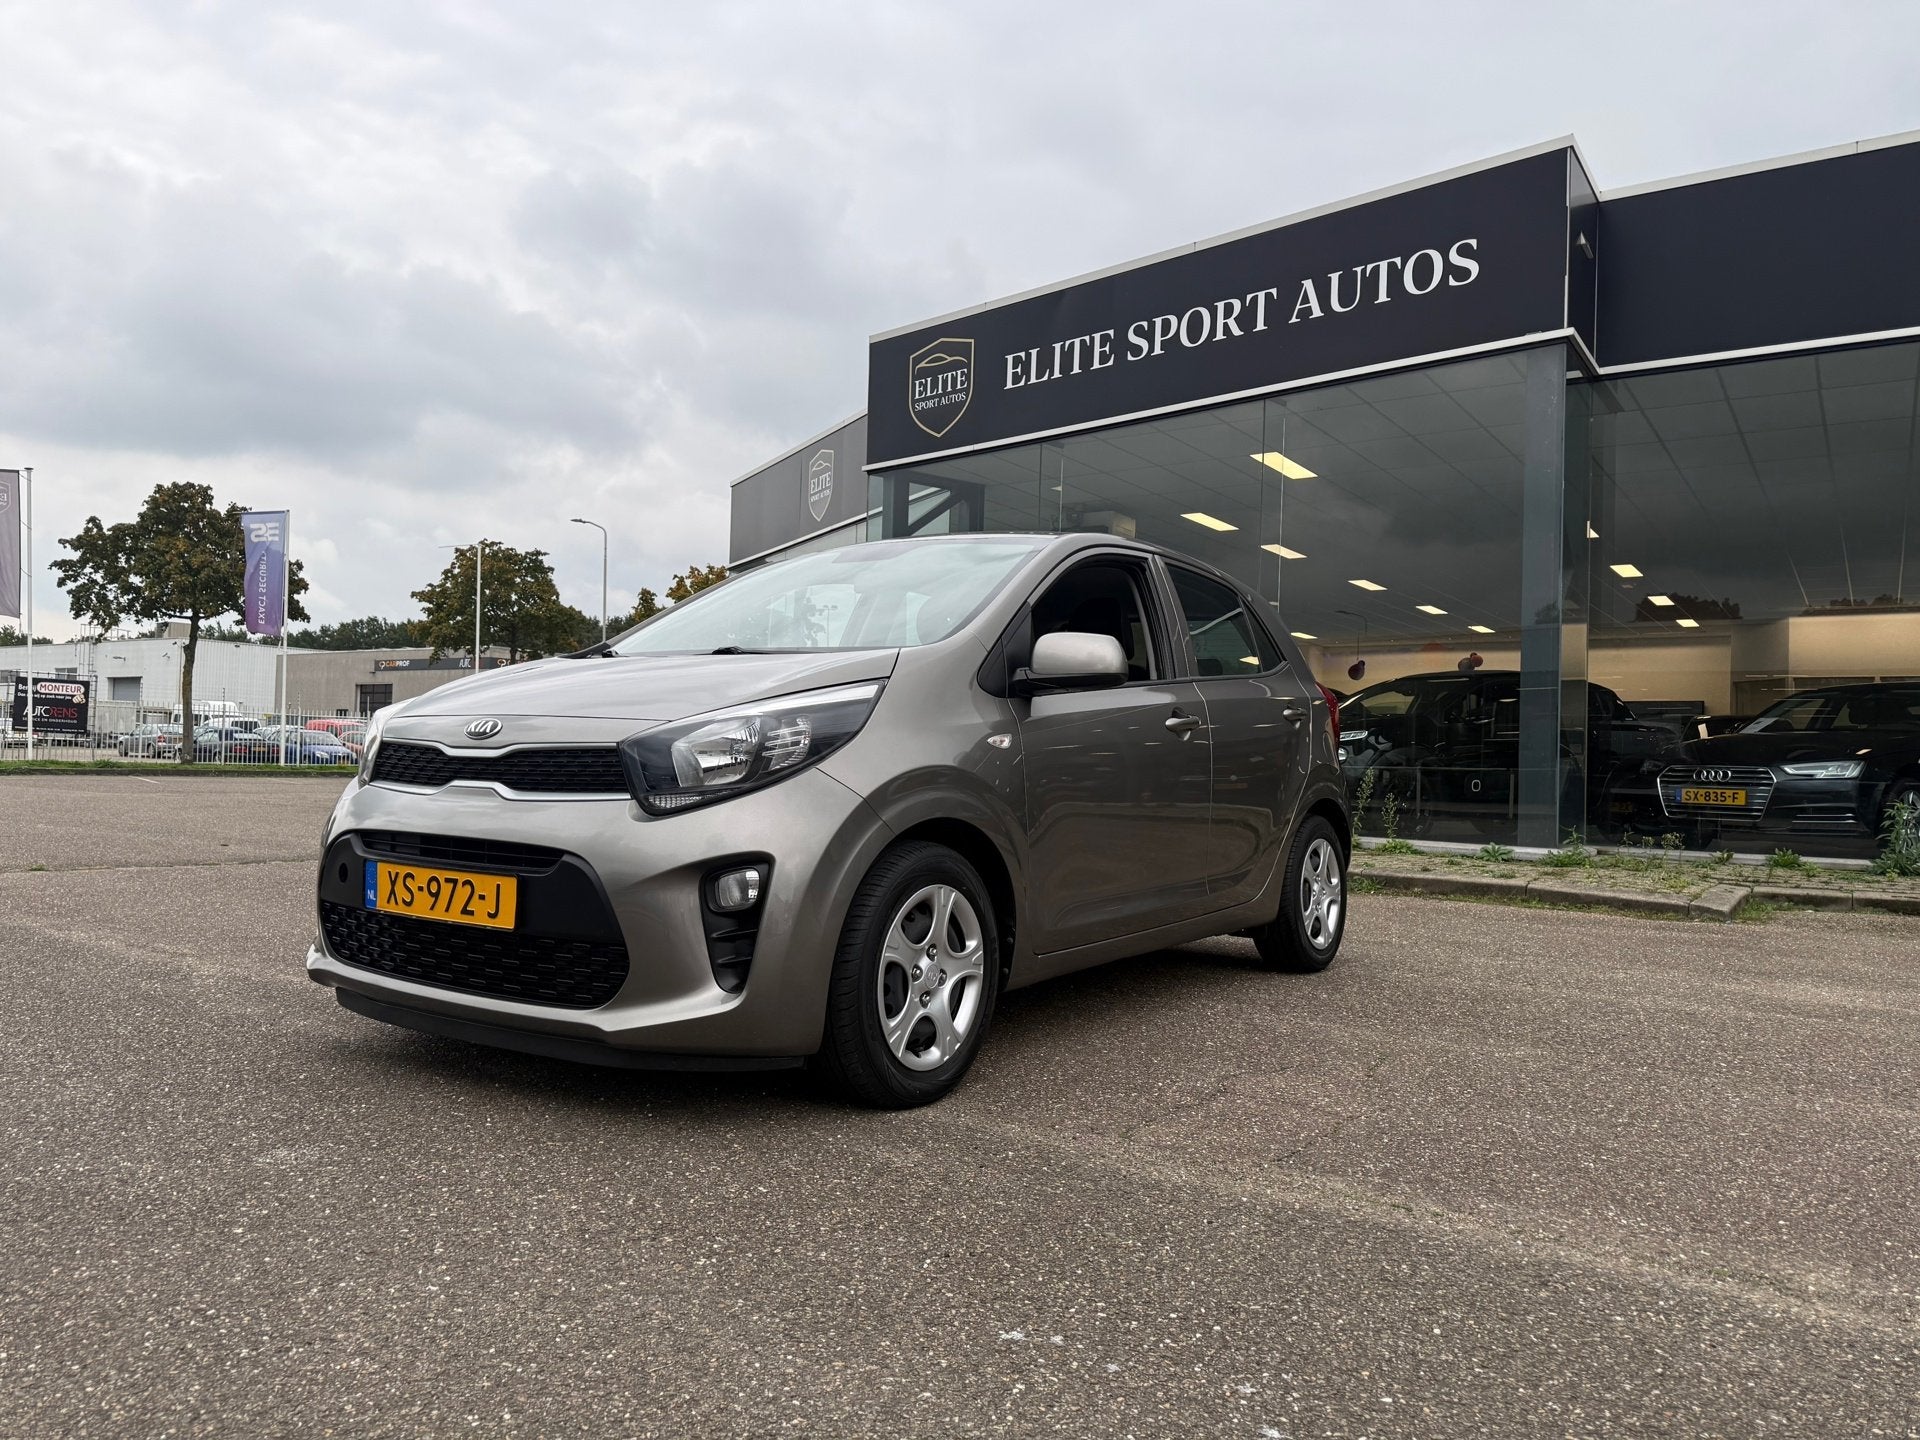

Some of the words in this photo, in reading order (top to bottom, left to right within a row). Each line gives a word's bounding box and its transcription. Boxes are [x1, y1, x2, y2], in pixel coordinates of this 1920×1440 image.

[1003, 329, 1115, 390] ELITE
[1127, 287, 1278, 361] SPORT
[1288, 238, 1480, 324] AUTOS
[914, 368, 968, 400] ELITE
[914, 398, 940, 412] SPORT
[940, 391, 967, 406] AUTOS
[810, 471, 832, 494] ELITE
[386, 660, 410, 668] CARPROF
[39, 683, 82, 693] MONTEUR
[467, 720, 494, 733] KIA
[1684, 790, 1740, 803] SX-835-F
[367, 889, 376, 901] NL
[386, 870, 501, 919] XS-972-J
